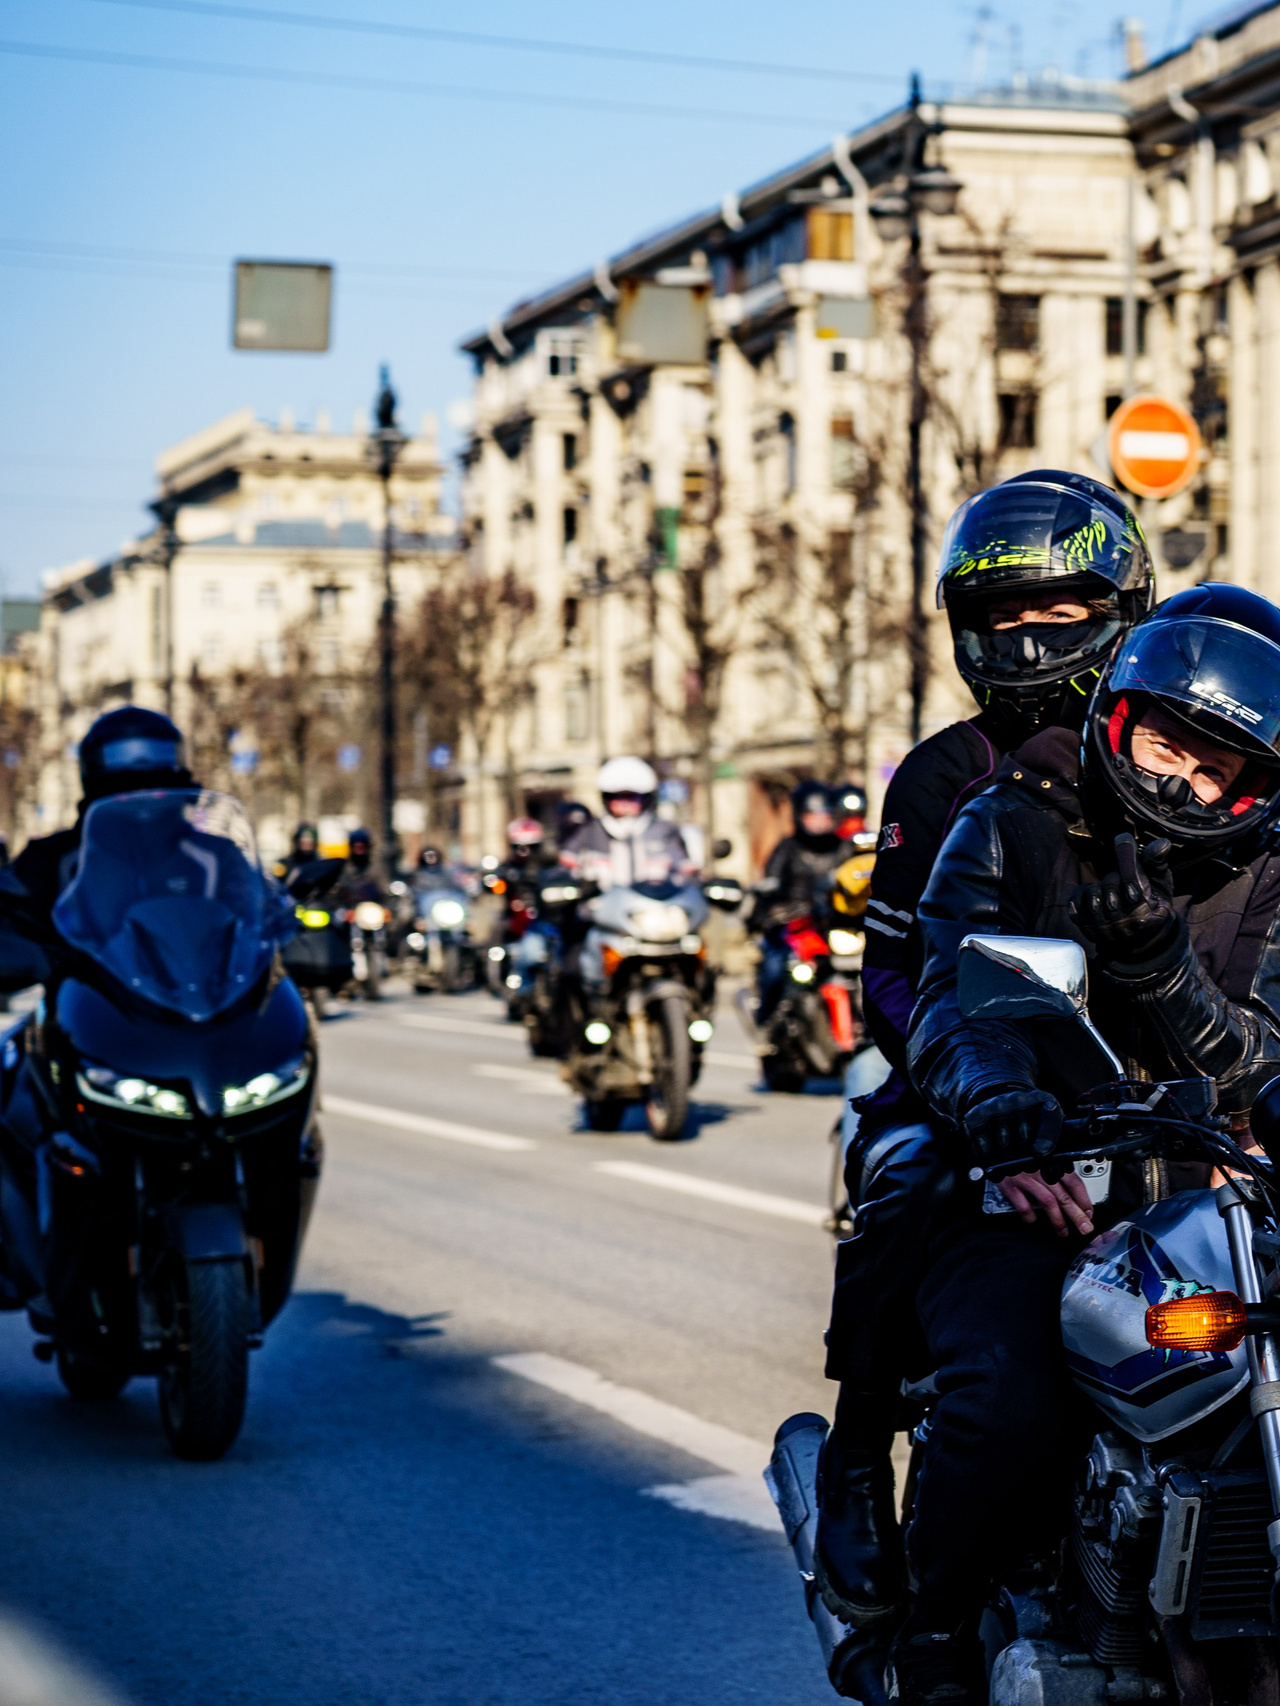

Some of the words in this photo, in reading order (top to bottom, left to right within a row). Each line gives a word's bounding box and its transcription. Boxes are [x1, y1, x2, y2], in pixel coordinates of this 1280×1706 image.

[977, 554, 1050, 571] LS2
[1188, 682, 1264, 725] LS2
[1091, 1281, 1115, 1293] VTEC
